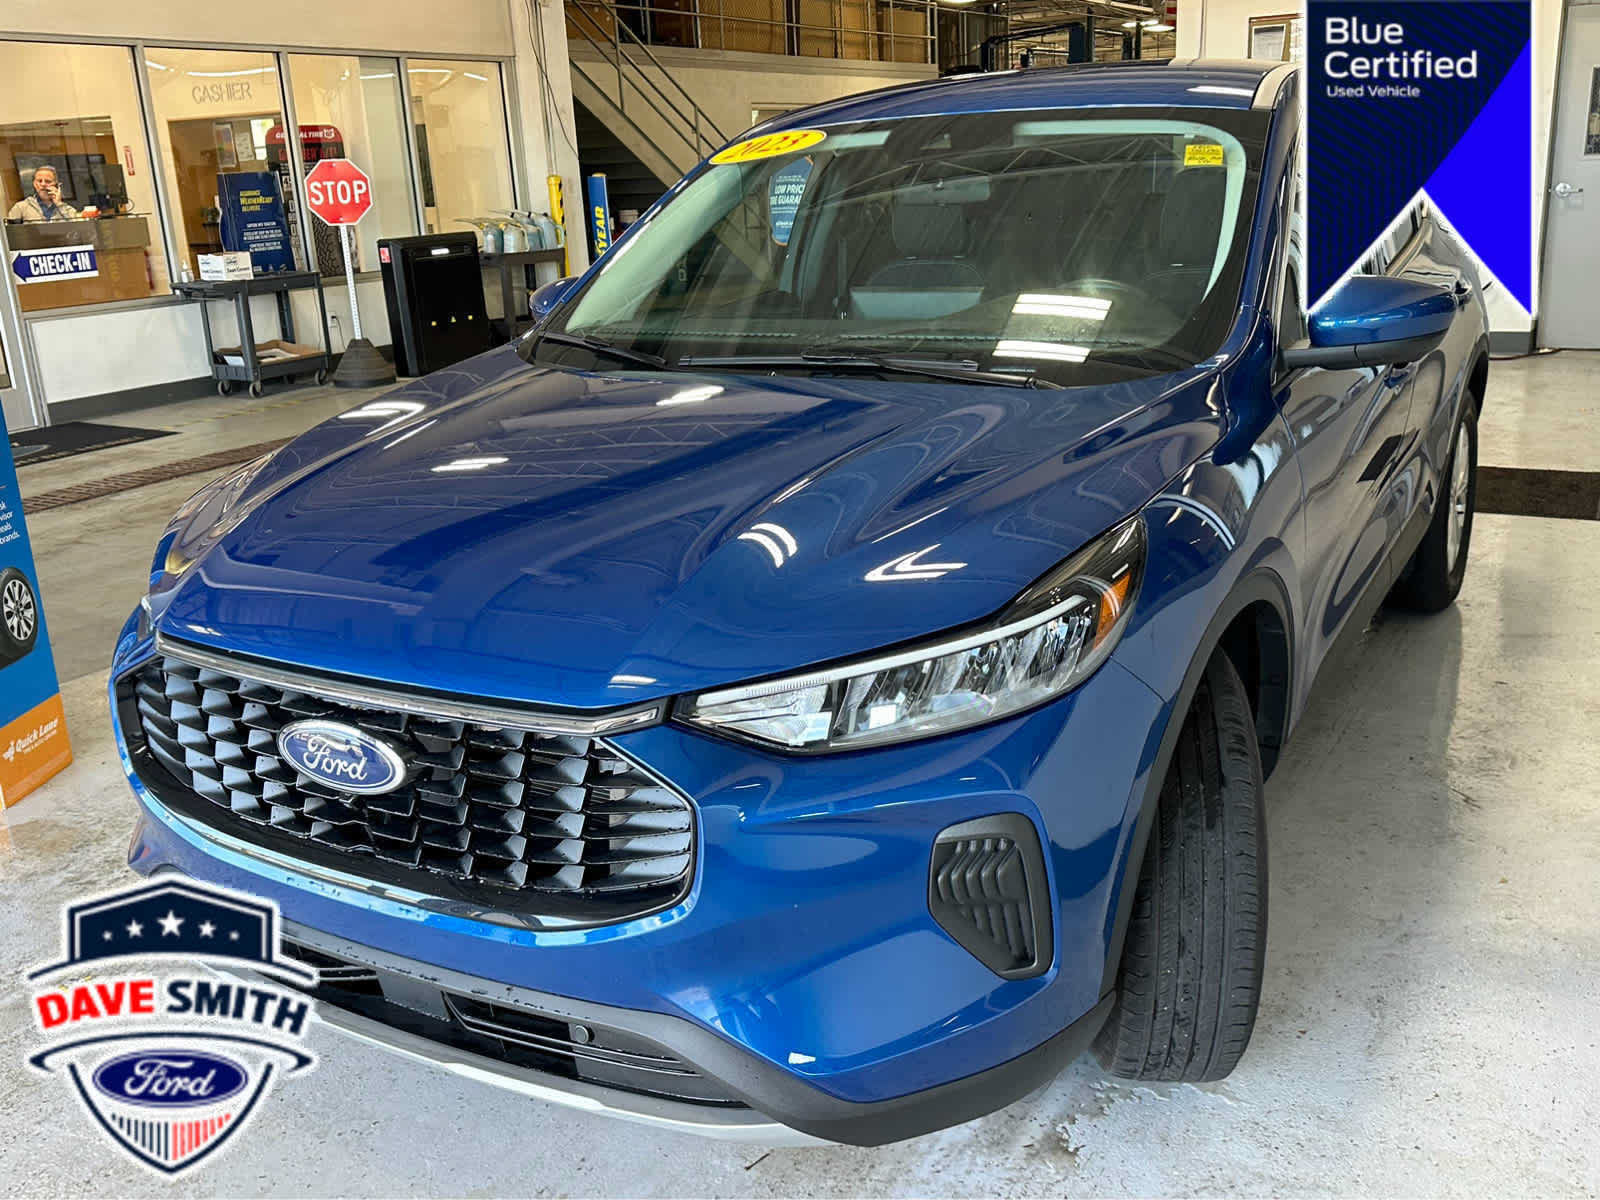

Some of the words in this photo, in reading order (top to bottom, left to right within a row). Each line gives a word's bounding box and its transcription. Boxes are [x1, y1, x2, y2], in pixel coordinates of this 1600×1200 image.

[191, 82, 252, 105] CASHIER
[310, 180, 367, 206] STOP
[29, 252, 92, 276] CHECK-IN
[15, 728, 39, 753] Quick
[39, 717, 59, 738] Lane
[303, 736, 368, 781] Ford
